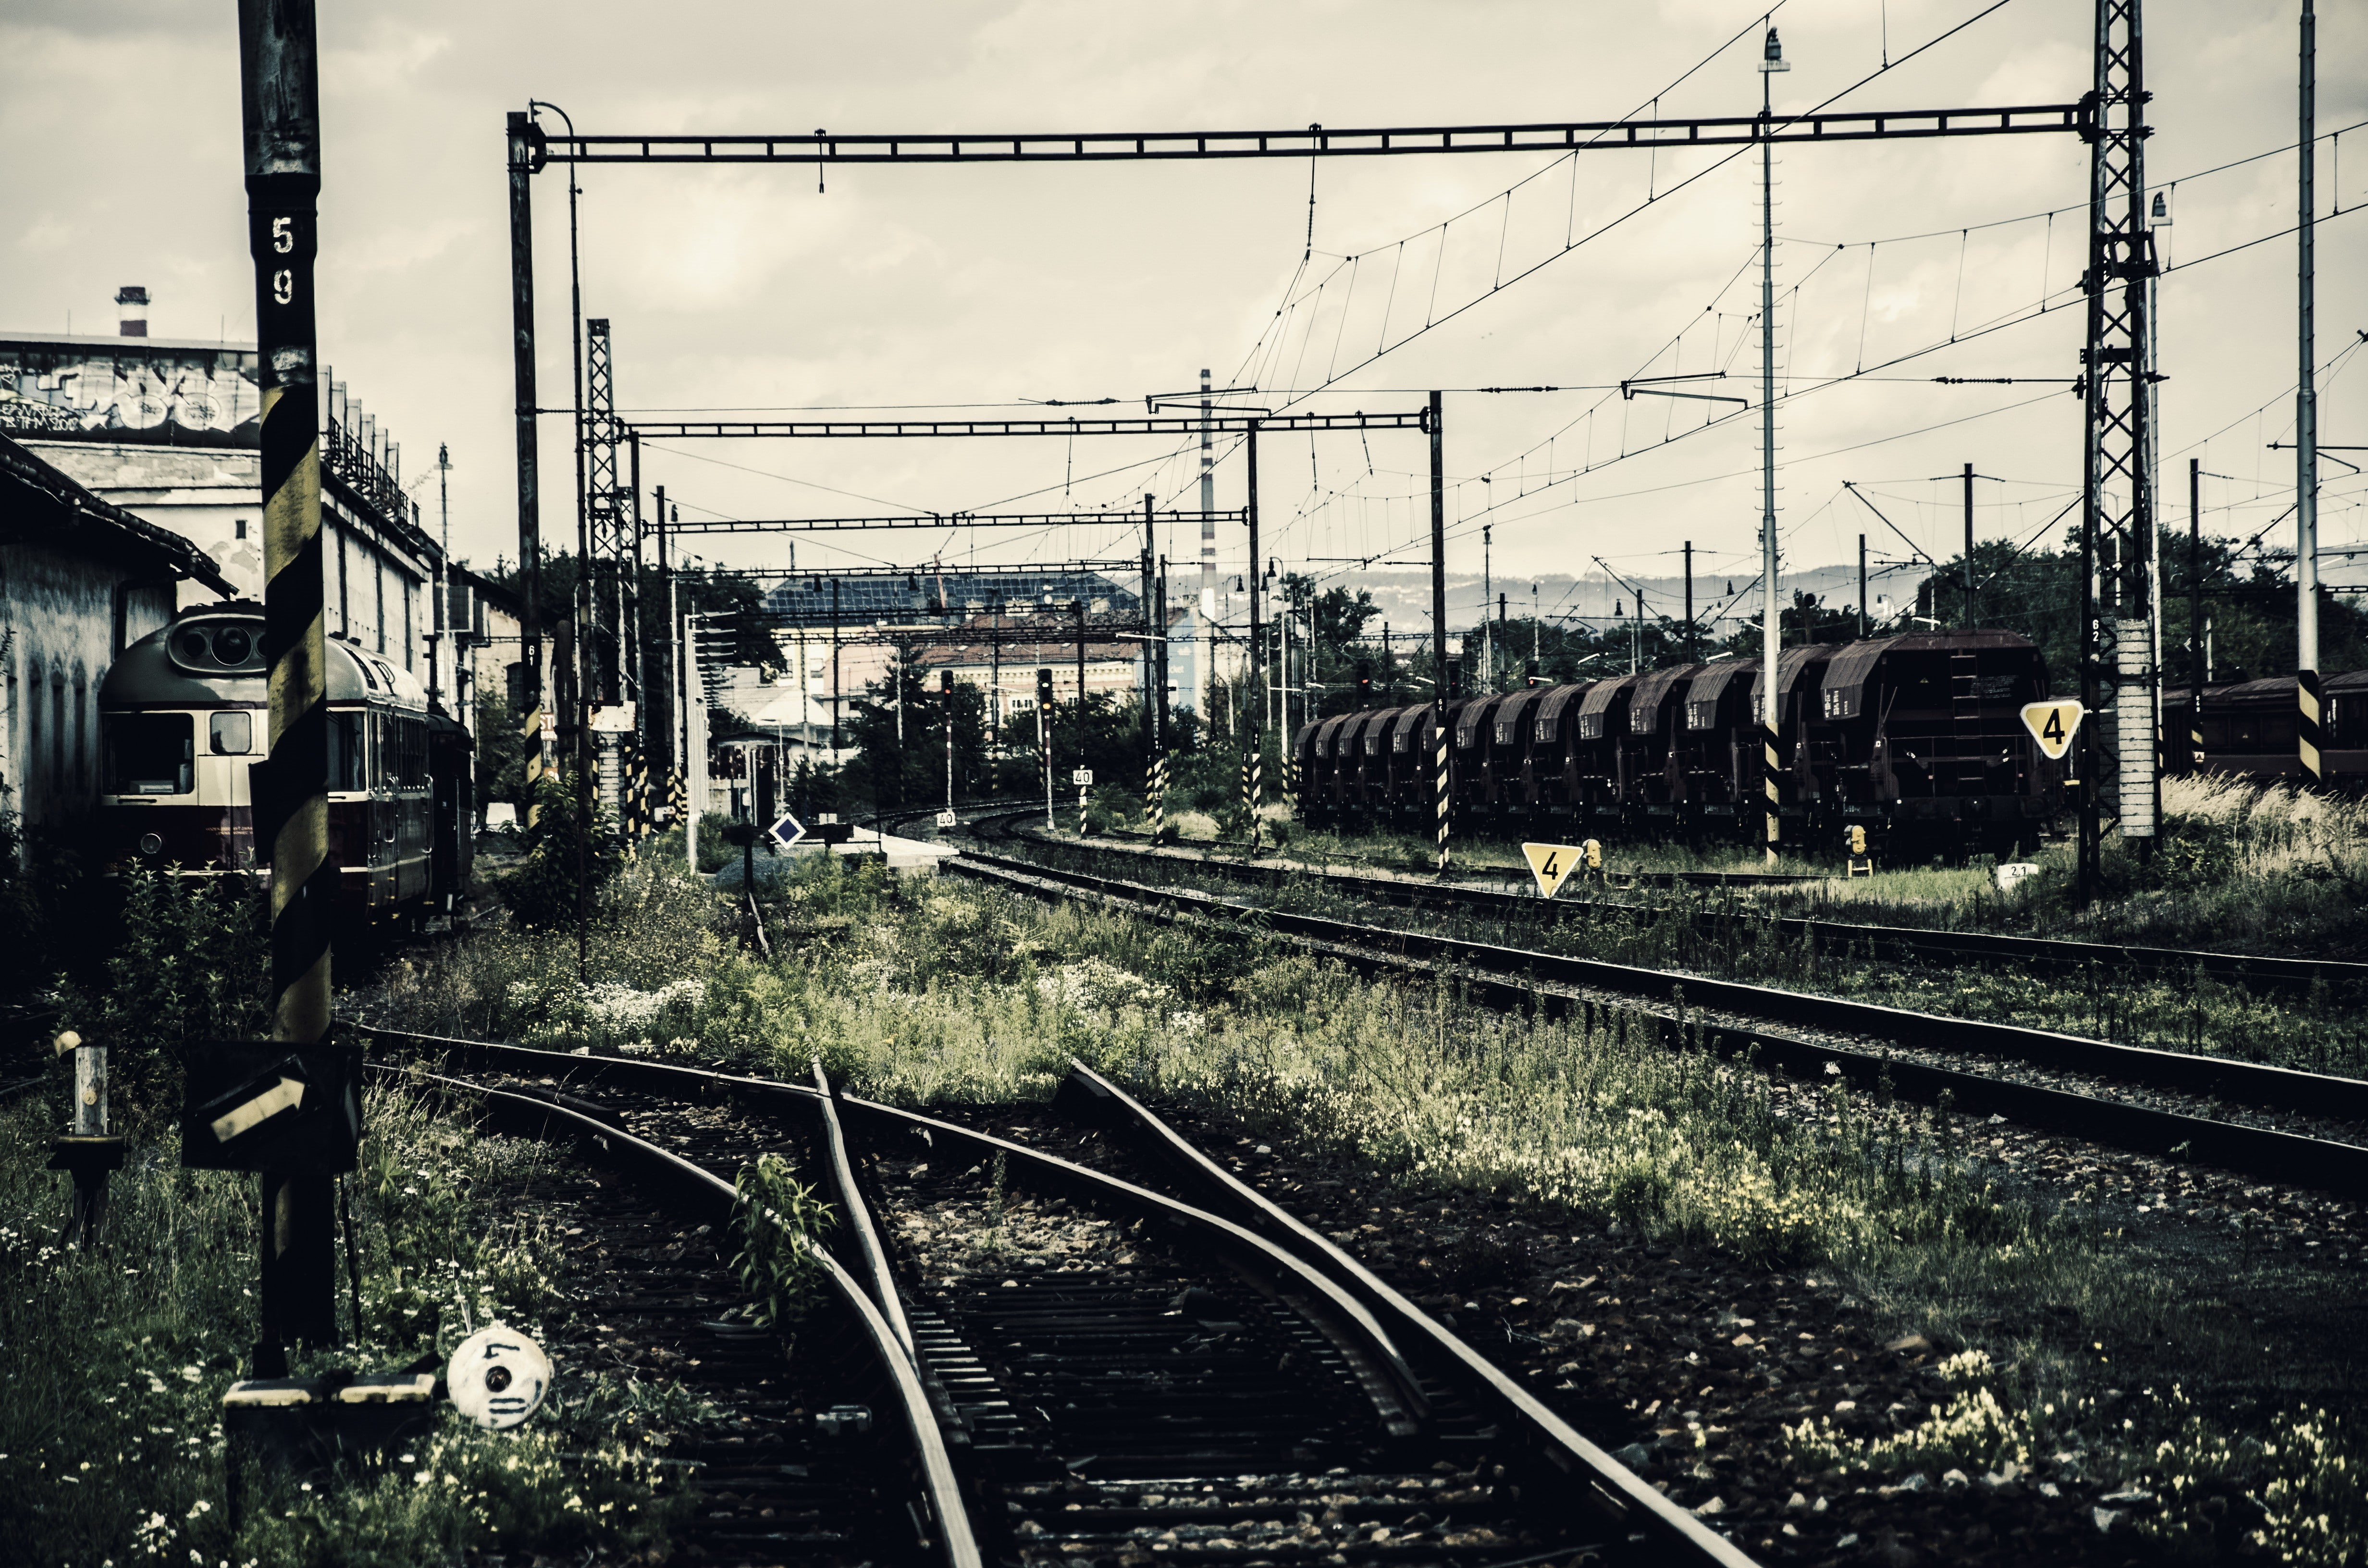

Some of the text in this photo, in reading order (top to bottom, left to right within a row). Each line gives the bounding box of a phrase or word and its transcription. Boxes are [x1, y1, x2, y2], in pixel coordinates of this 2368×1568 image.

[2092, 619, 2099, 642] 62
[2043, 709, 2065, 745] 4
[1075, 772, 1089, 783] 40
[940, 814, 952, 823] 40
[1542, 851, 1558, 880] 4
[2011, 866, 2026, 876] 2.1
